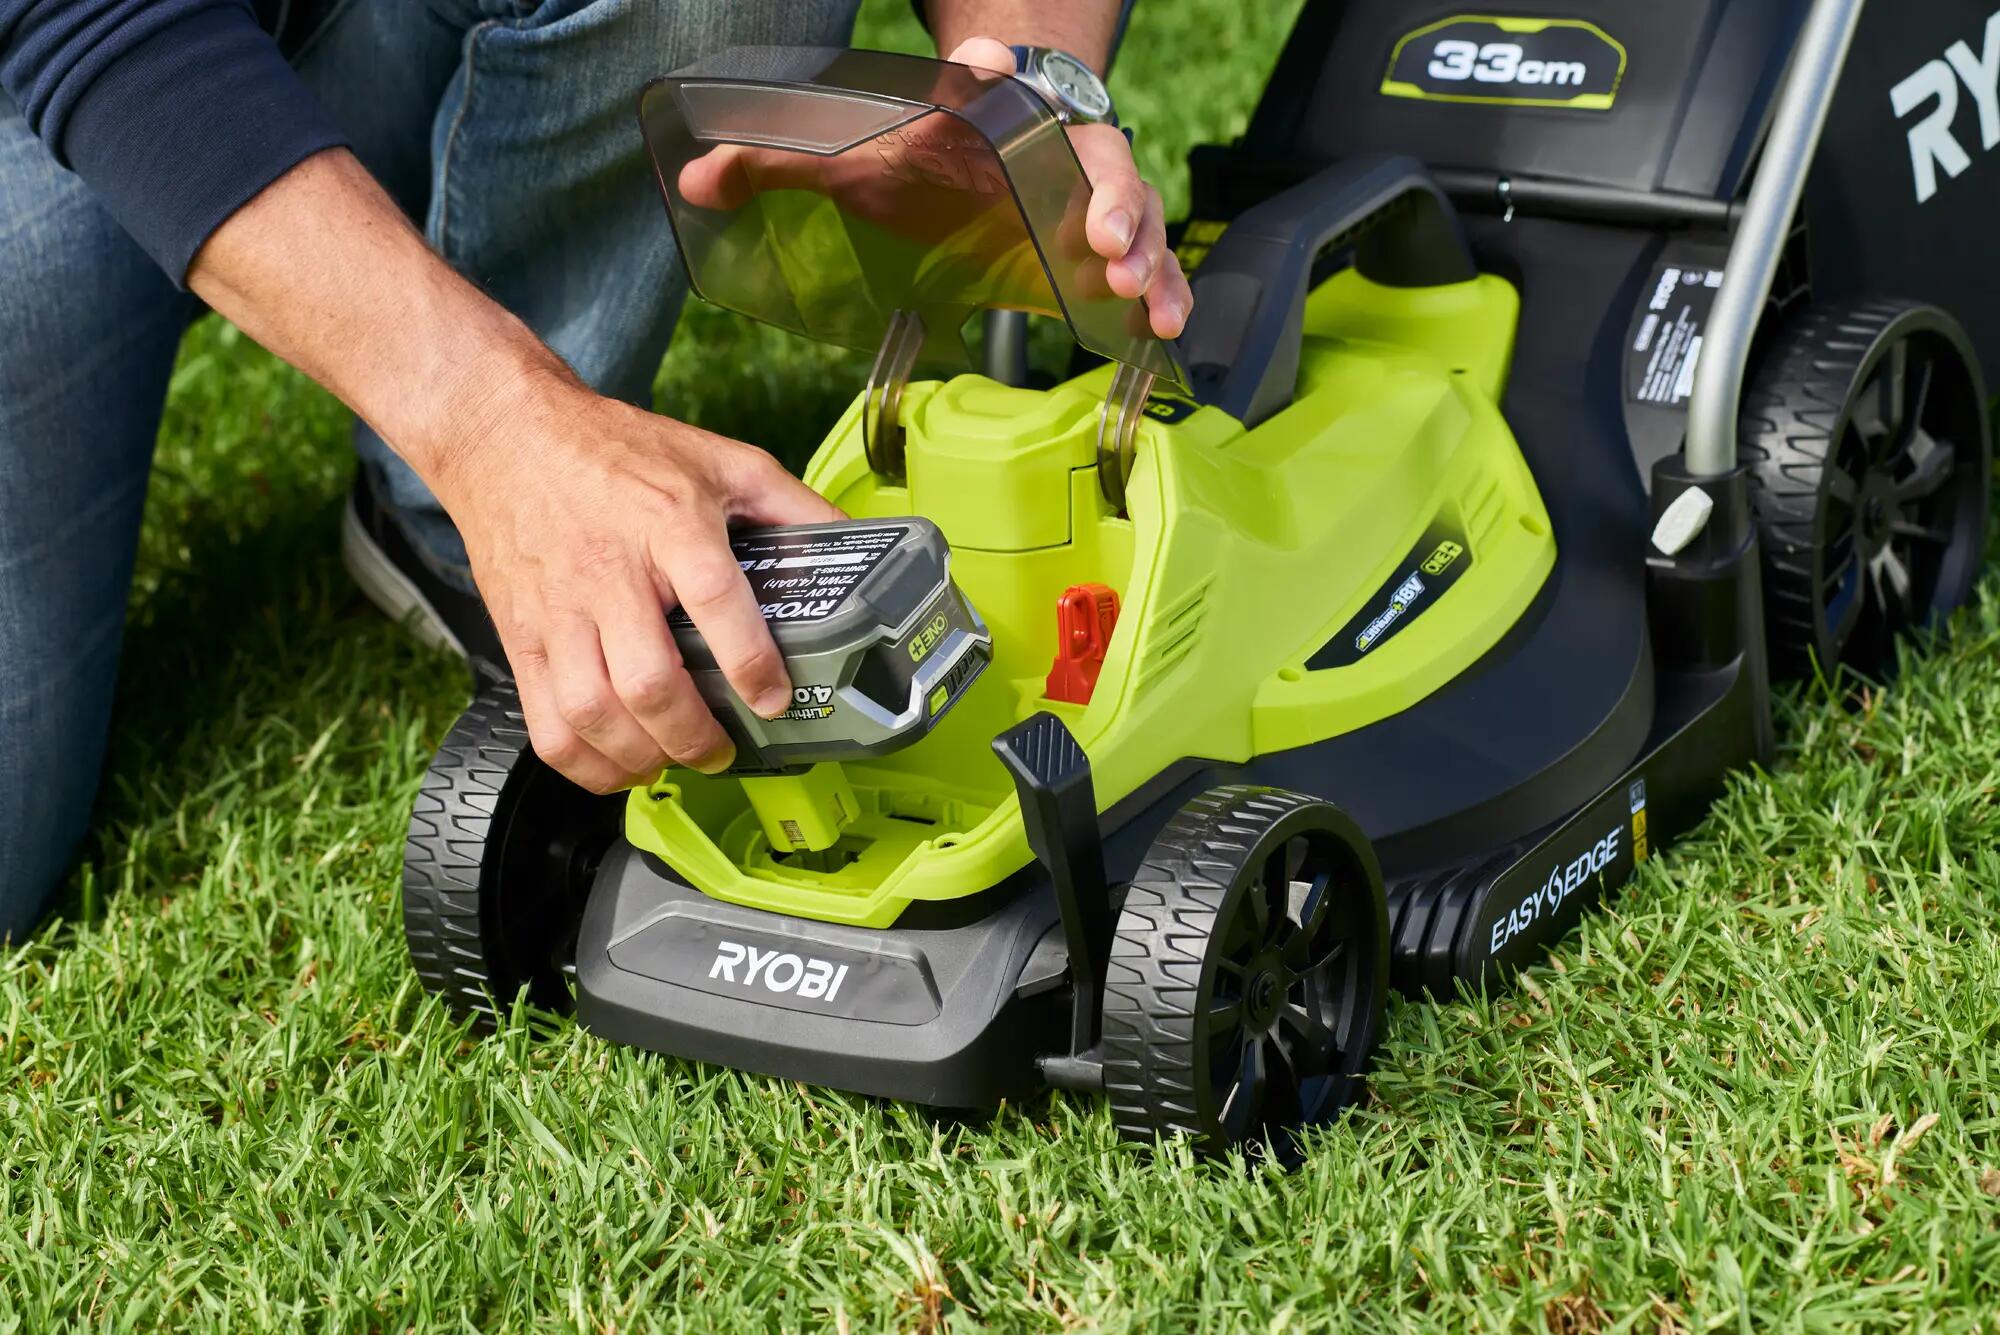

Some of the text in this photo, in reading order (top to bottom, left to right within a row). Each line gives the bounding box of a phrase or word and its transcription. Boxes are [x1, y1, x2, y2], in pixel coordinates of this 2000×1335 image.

[1427, 39, 1587, 86] 33cm
[762, 574, 858, 590] 72Wh (4.0Ah)
[803, 586, 847, 597] 18.0V
[760, 599, 838, 619] RYOB
[1489, 828, 1620, 955] EASY EDGE
[708, 941, 849, 1003] RYOBI
